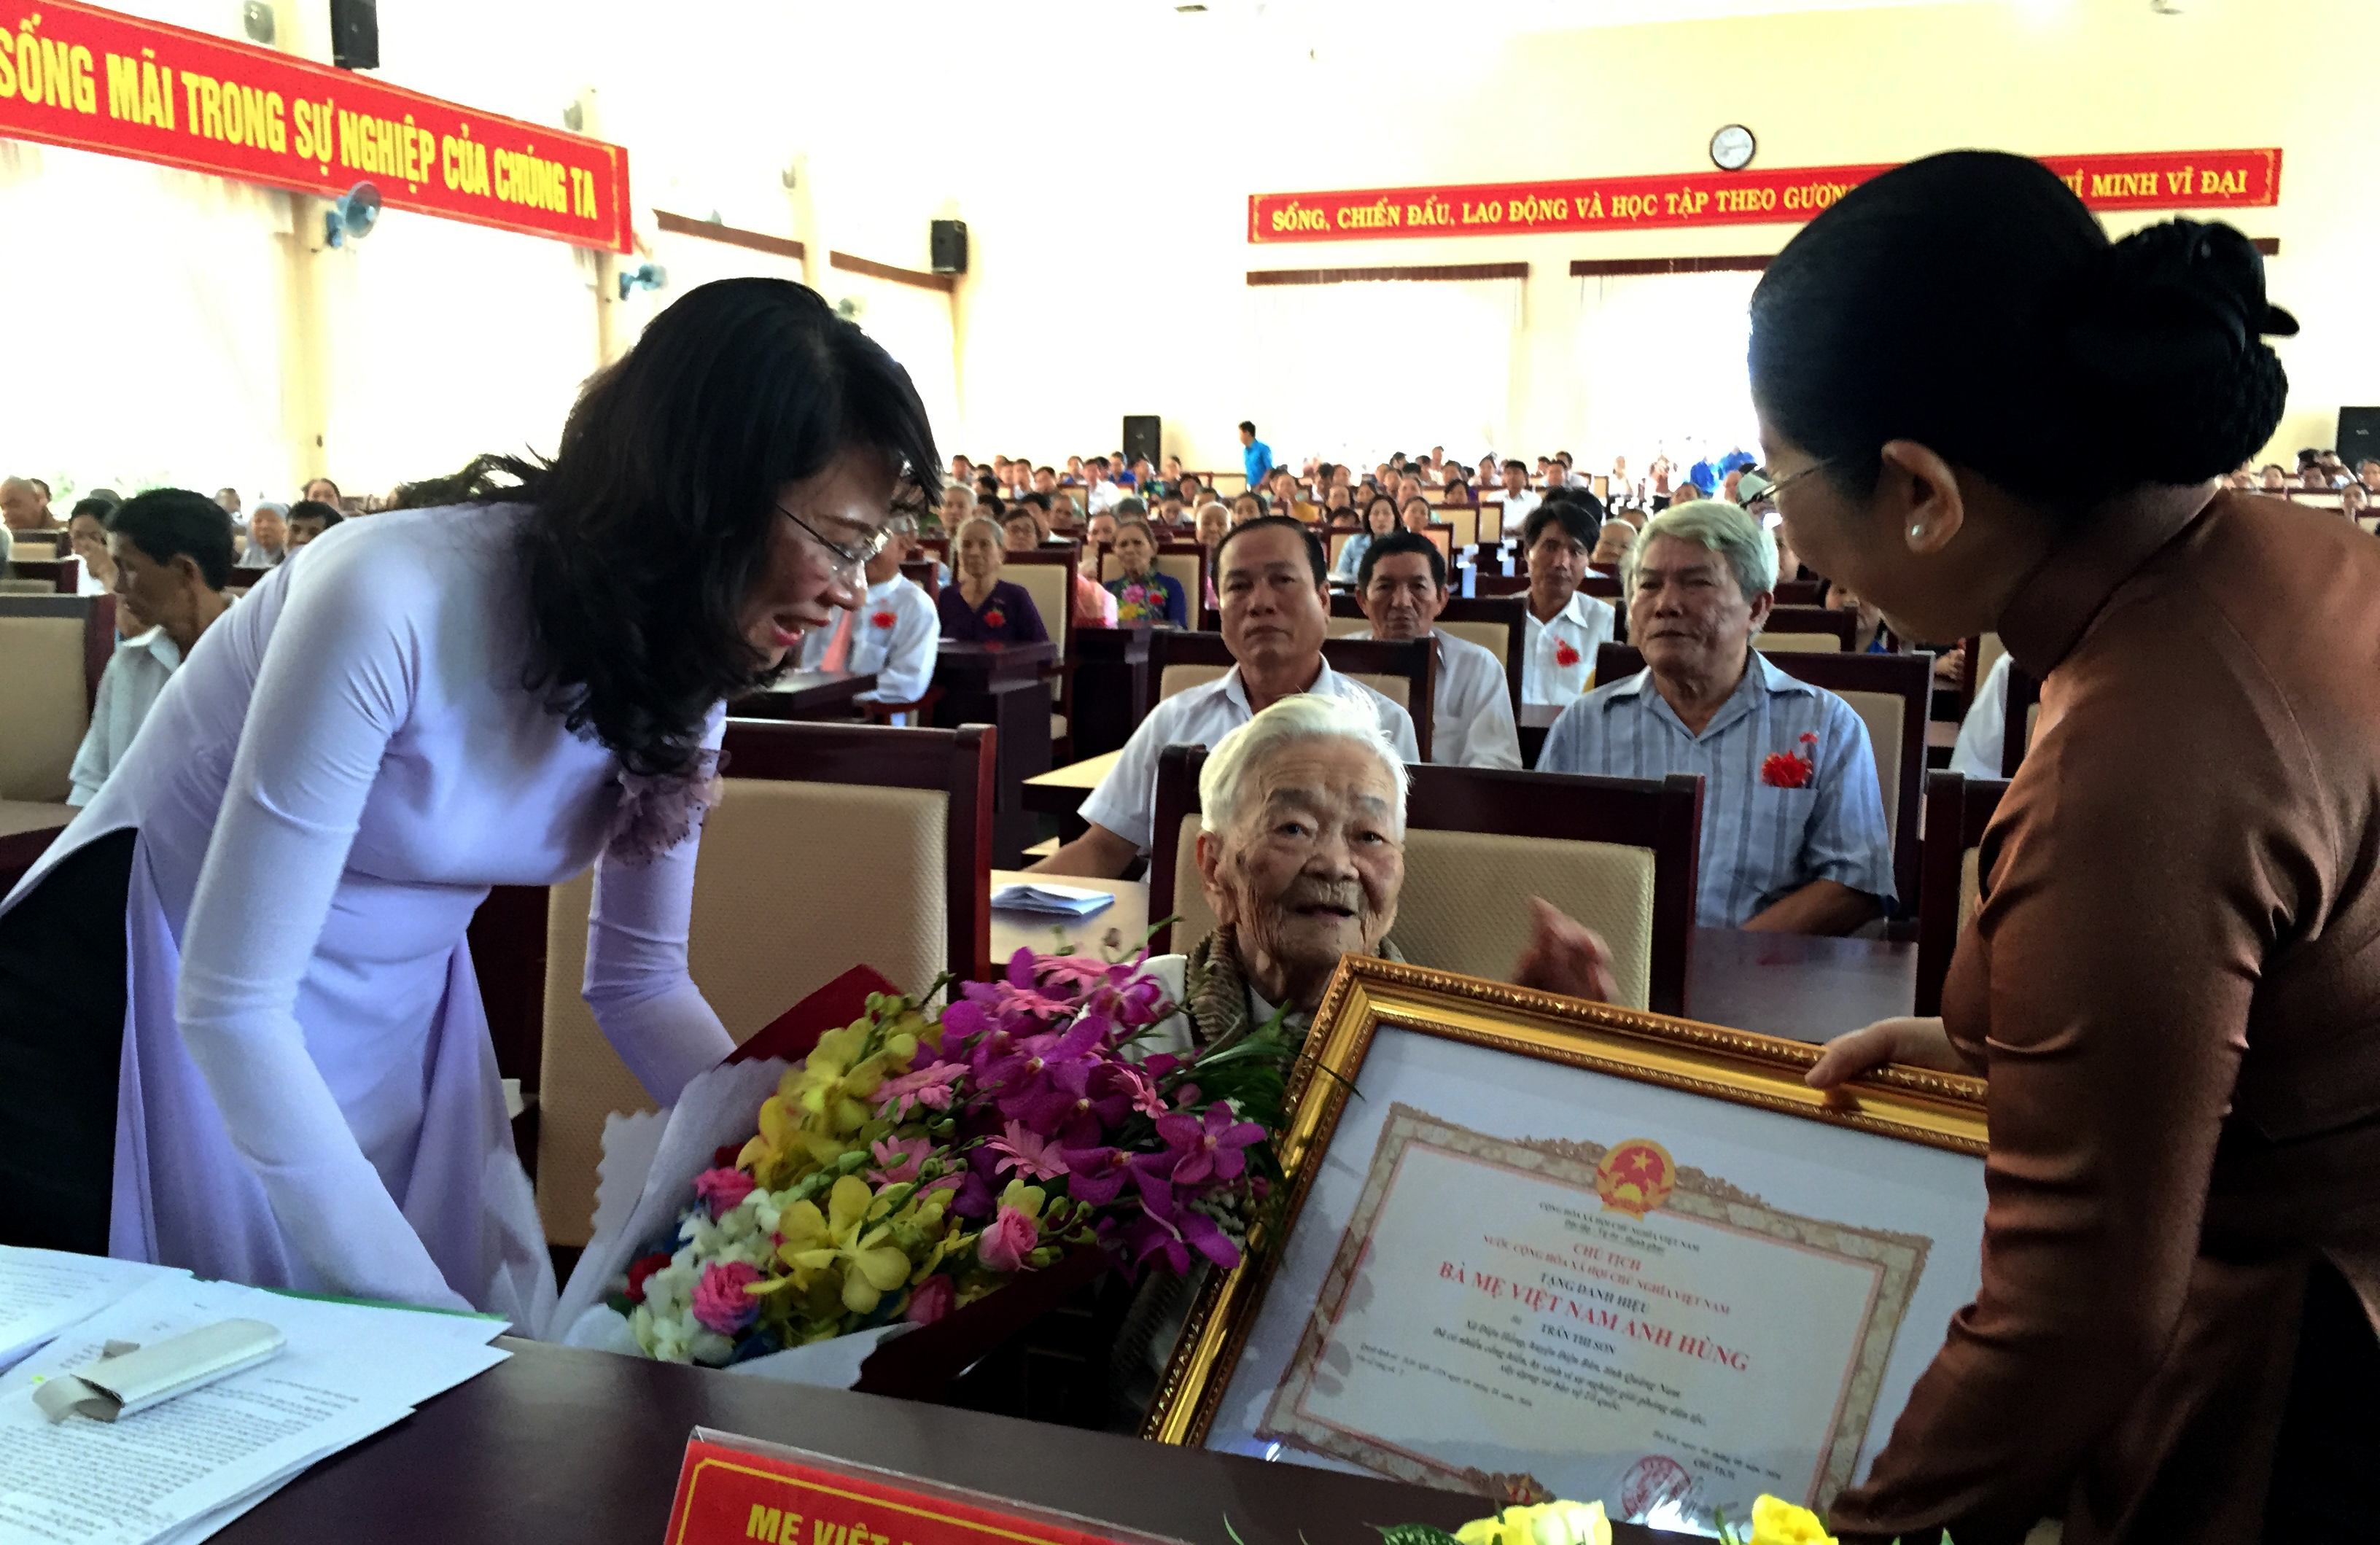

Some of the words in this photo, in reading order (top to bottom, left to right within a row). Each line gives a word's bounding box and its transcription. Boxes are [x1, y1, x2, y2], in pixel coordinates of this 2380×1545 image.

[0, 12, 96, 114] SỐNG
[106, 48, 175, 131] MÃI
[180, 71, 287, 154] TRONG
[293, 96, 333, 176] SỰ
[340, 114, 435, 193] NGHIỆP
[441, 124, 490, 197] CỦA
[494, 144, 567, 213] CHÚNG
[571, 167, 598, 221] TA
[1272, 200, 1331, 232] SỐNG,
[1336, 196, 1401, 229] CHIẾN
[1407, 195, 1456, 227] ĐẤU,
[1461, 200, 1503, 225] LAO
[1507, 194, 1568, 227] ĐỘNG
[1574, 190, 1605, 220] VÀ
[1610, 194, 1659, 221] HỌC
[1665, 187, 1709, 219] TẬP
[1716, 189, 1776, 213] THEO
[1784, 182, 1859, 210] GƯƠN
[2091, 173, 2159, 198] MINH
[2200, 169, 2247, 198] ĐẠI
[1439, 1260, 1466, 1285] BÀ
[1471, 1271, 1506, 1299] MẸ
[1512, 1283, 1563, 1312] VIỆT
[1566, 1299, 1618, 1331] NAM
[1620, 1318, 1673, 1348] ANH
[1677, 1334, 1749, 1371] HÙNG
[1576, 1283, 1614, 1304] DANH
